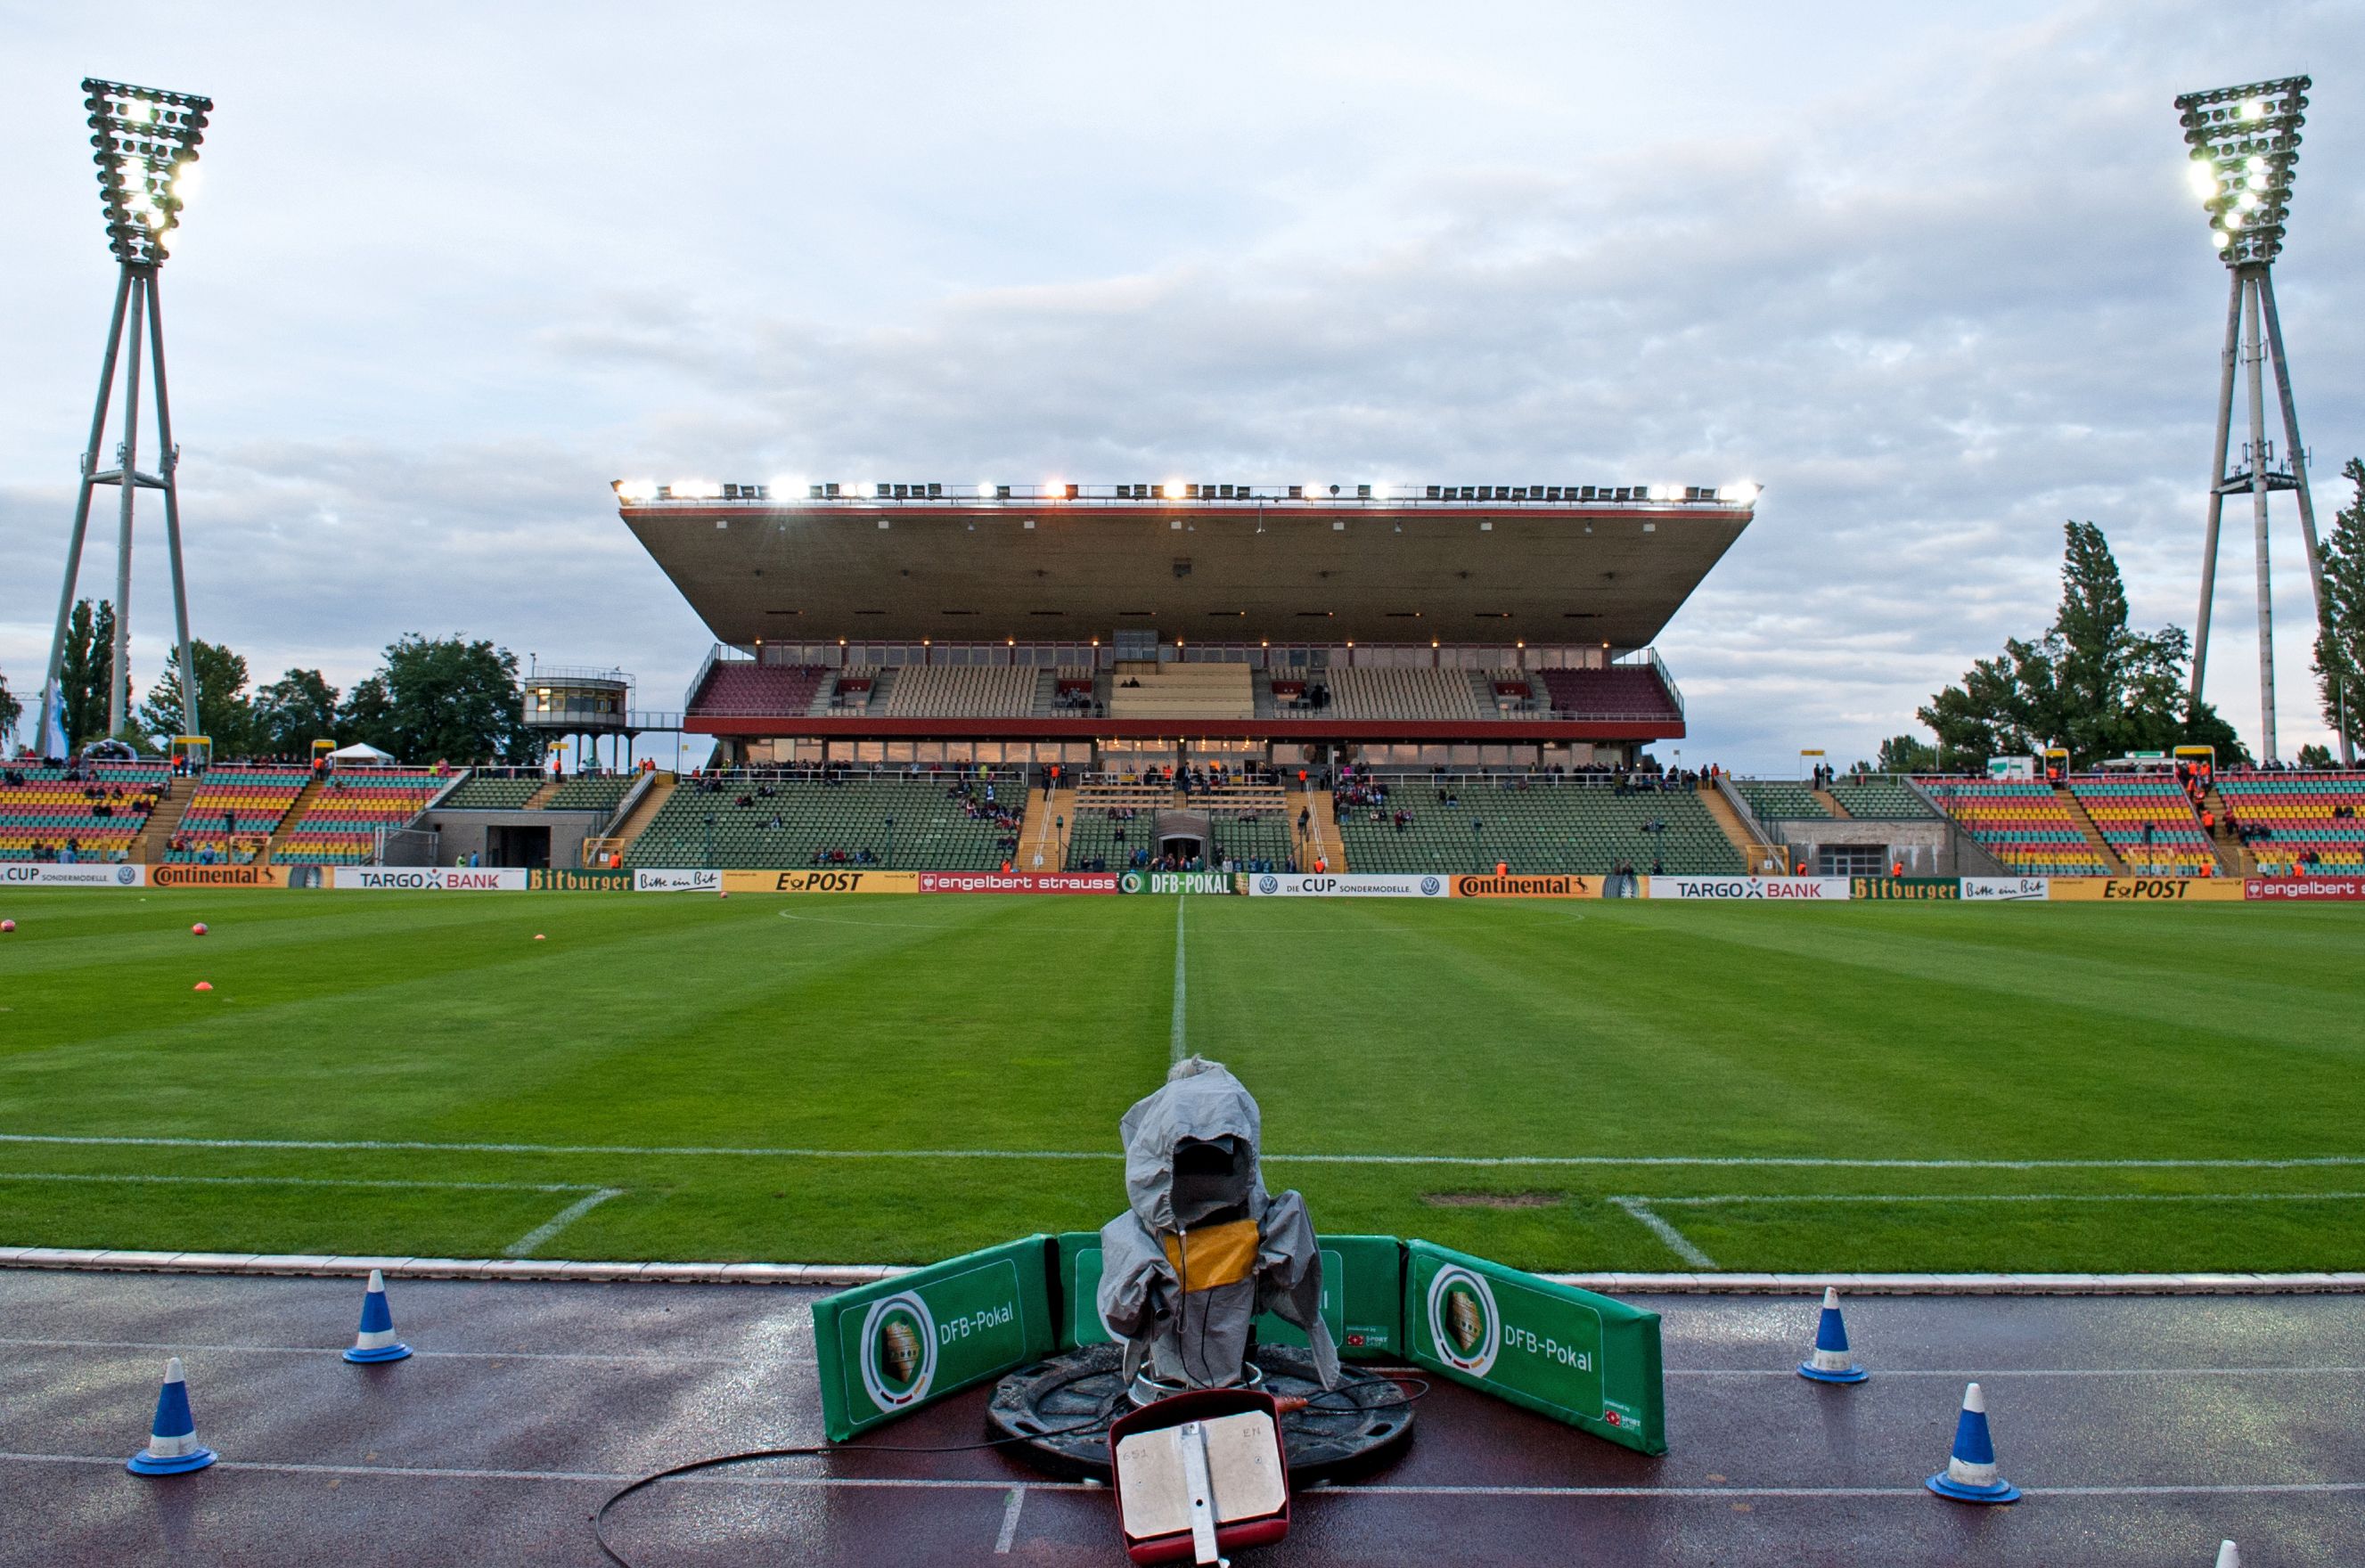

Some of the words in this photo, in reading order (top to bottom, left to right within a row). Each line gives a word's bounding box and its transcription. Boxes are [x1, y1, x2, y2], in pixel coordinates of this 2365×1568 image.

[7, 868, 39, 880] CUP
[152, 866, 258, 886] Continental
[360, 873, 423, 887] TARGO
[447, 874, 499, 888] BANK
[529, 870, 631, 890] Bitburger
[641, 873, 667, 889] Bitte
[672, 878, 691, 886] ein
[694, 871, 717, 885] Bit
[938, 876, 1032, 890] engelbert
[1039, 877, 1115, 889] strauss
[1151, 874, 1231, 894] DFB-POKAL
[1303, 878, 1337, 892] CUP
[1459, 876, 1570, 896] Continental
[1677, 883, 1743, 897] TARGO
[1767, 884, 1821, 898] BANK
[1854, 878, 1957, 899] Bitburger
[1966, 882, 1993, 897] Bitte
[1999, 886, 2017, 894] ein
[2020, 879, 2044, 891] Bit
[2264, 881, 2354, 897] engelbert
[940, 1301, 1014, 1345] DFB-Pokal
[1504, 1324, 1592, 1372] DFB-Pokal
